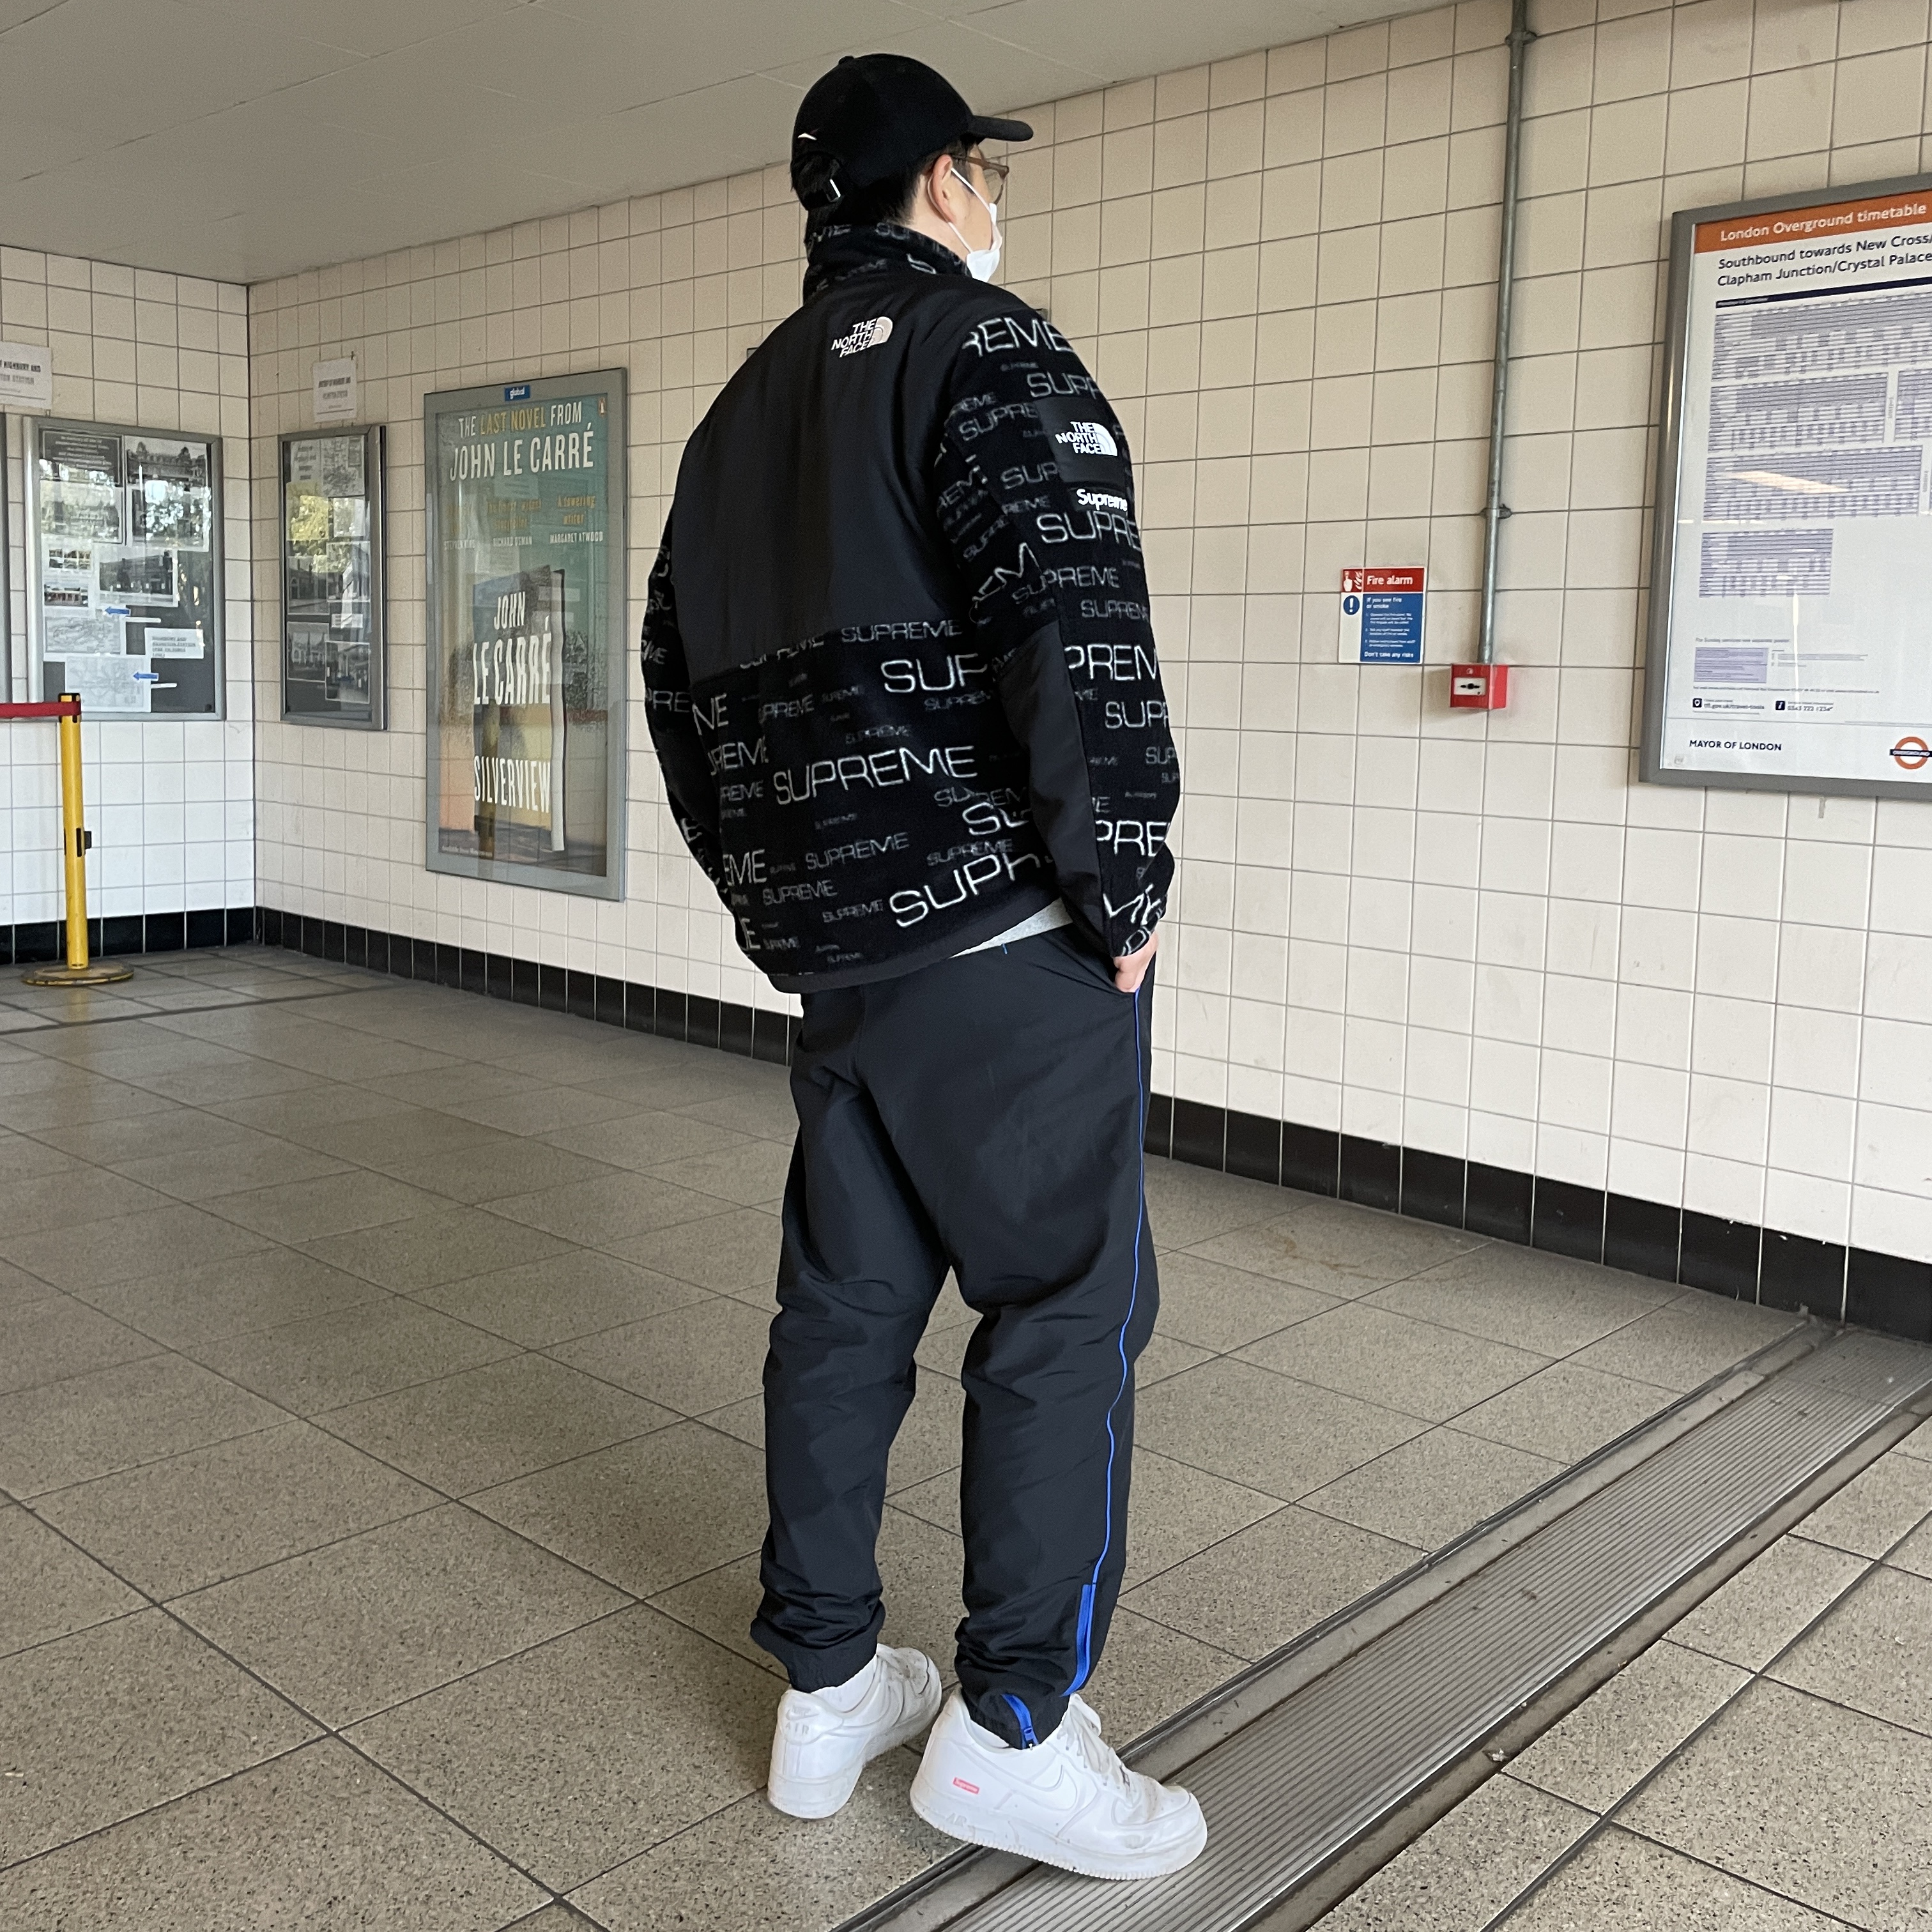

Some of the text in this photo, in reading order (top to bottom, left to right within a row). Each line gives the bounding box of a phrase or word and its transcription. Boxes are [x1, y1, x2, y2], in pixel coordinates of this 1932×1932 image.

[1721, 203, 1927, 241] London Overground timetable
[1718, 250, 1796, 270] Southbound
[1799, 243, 1851, 259] towards
[1855, 240, 1887, 252] New
[1717, 273, 1773, 287] Clapham
[1775, 256, 1885, 280] Junction/Crystal
[831, 329, 873, 351] NORTH
[852, 318, 877, 334] THE
[839, 339, 870, 358] FACE
[458, 401, 582, 438] THE LAST NOVEL FROM
[1070, 421, 1094, 433] THE
[450, 422, 594, 481] JOHN LE CARRÉ
[1055, 431, 1098, 444] NORTH
[1073, 443, 1102, 454] FACE
[1076, 488, 1128, 512] Supreme
[1367, 575, 1413, 585] Fire alarm
[493, 591, 526, 630] JOHN
[473, 616, 552, 705] LE CARRÉ
[1689, 740, 1722, 748] MAYOR
[1739, 742, 1782, 751] LONDON
[473, 755, 551, 813] SILVERVIEW
[773, 745, 978, 805] SUPREME
[805, 832, 911, 870] SUPREME
